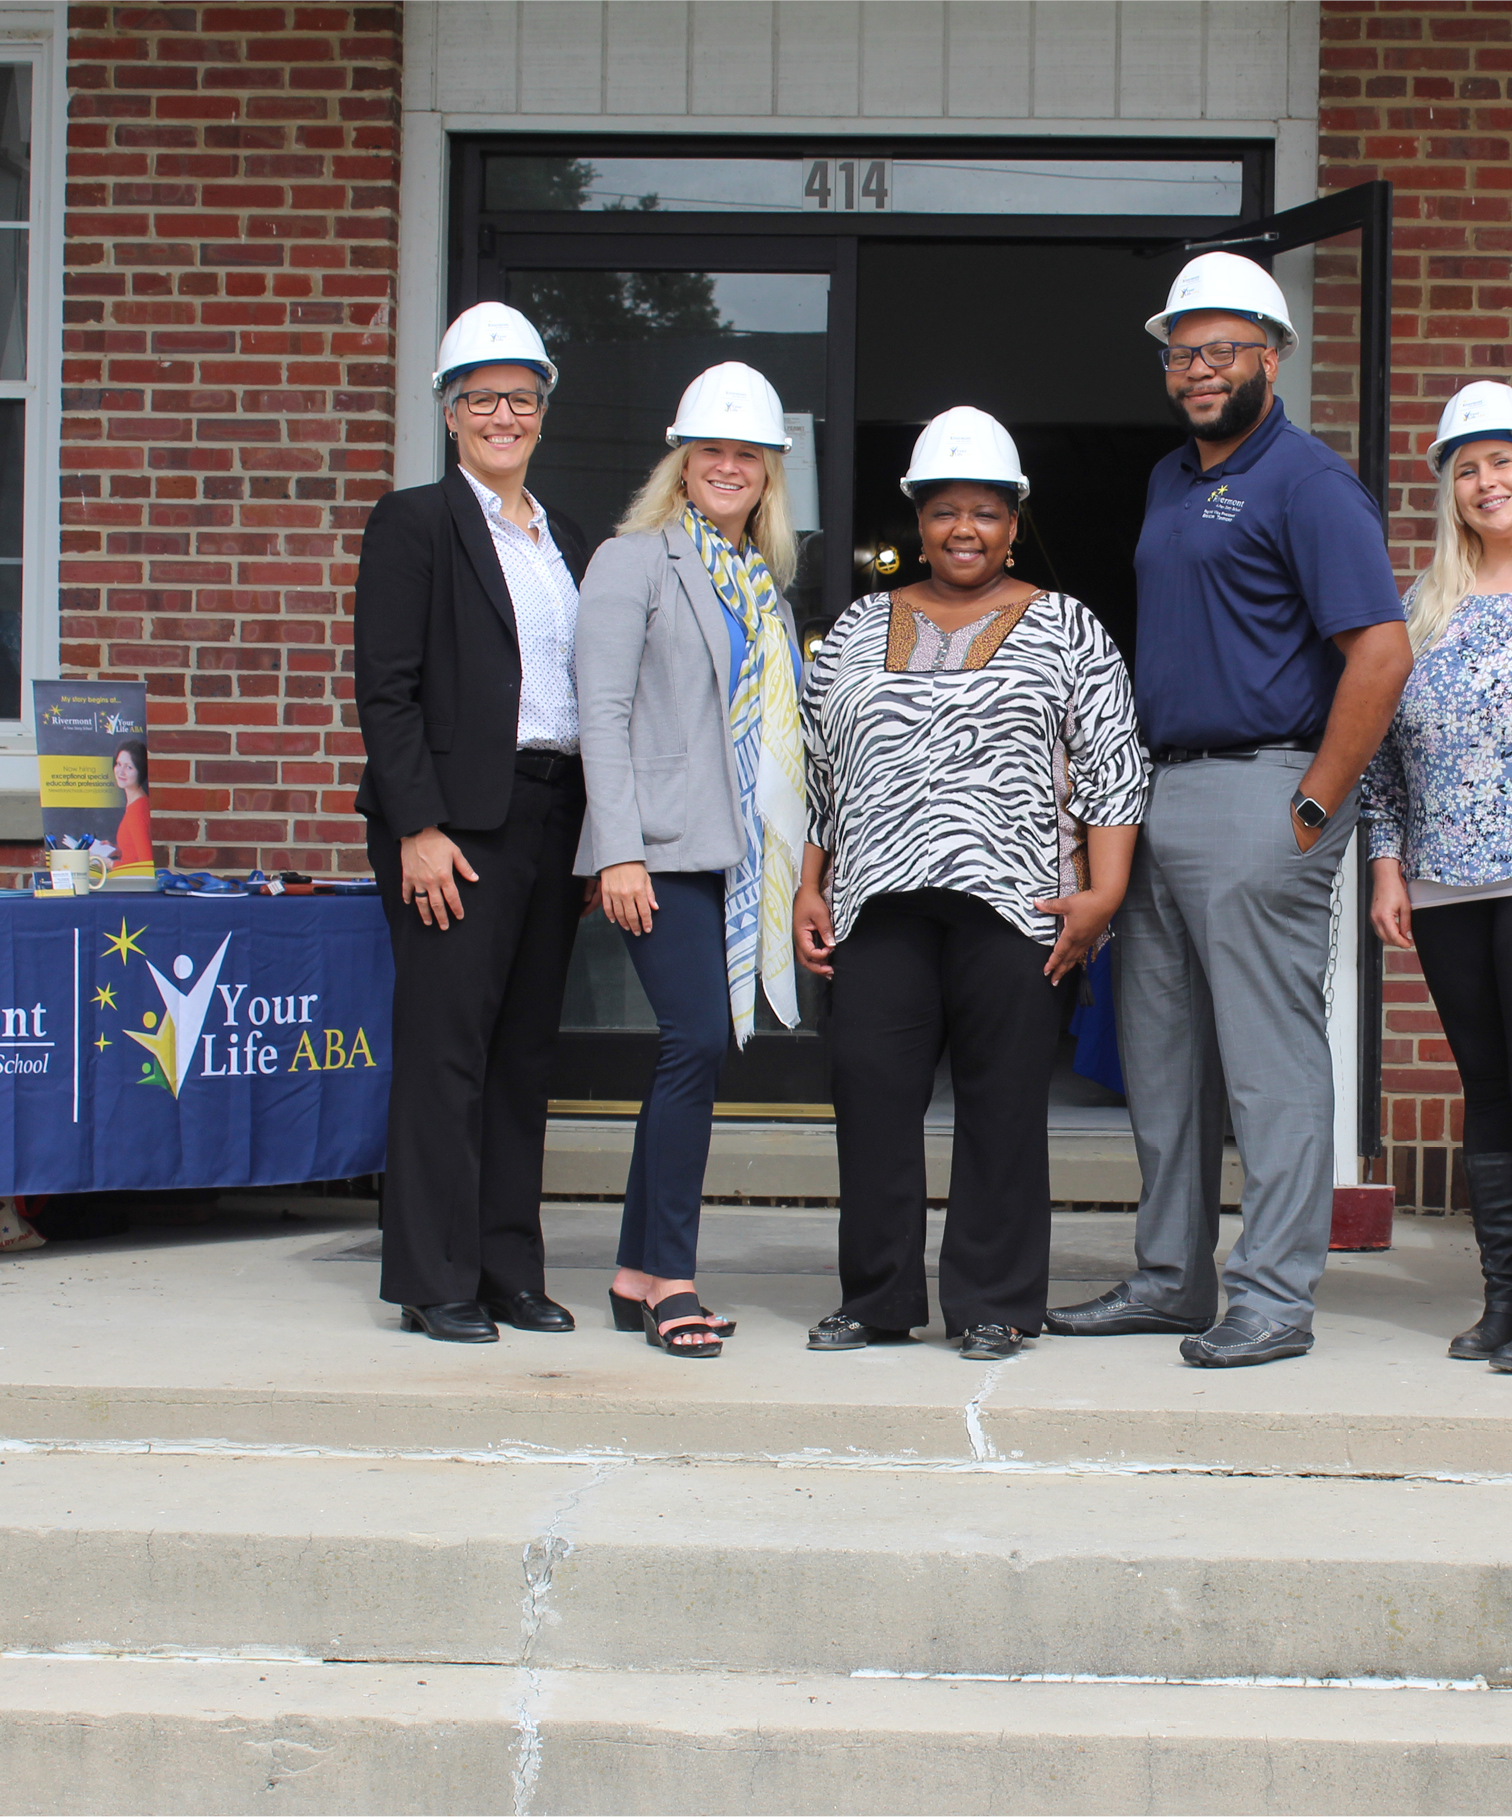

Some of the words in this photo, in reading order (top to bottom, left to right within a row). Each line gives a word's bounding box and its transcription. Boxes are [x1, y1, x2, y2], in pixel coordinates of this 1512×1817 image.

[805, 161, 888, 209] 414
[61, 696, 71, 704] My
[72, 696, 87, 704] story
[88, 696, 109, 705] begins
[51, 716, 92, 725] Rivermont
[117, 718, 134, 726] Your
[115, 725, 129, 733] Life
[216, 984, 318, 1027] Your
[201, 1031, 278, 1076] Life
[287, 1027, 377, 1073] ABA
